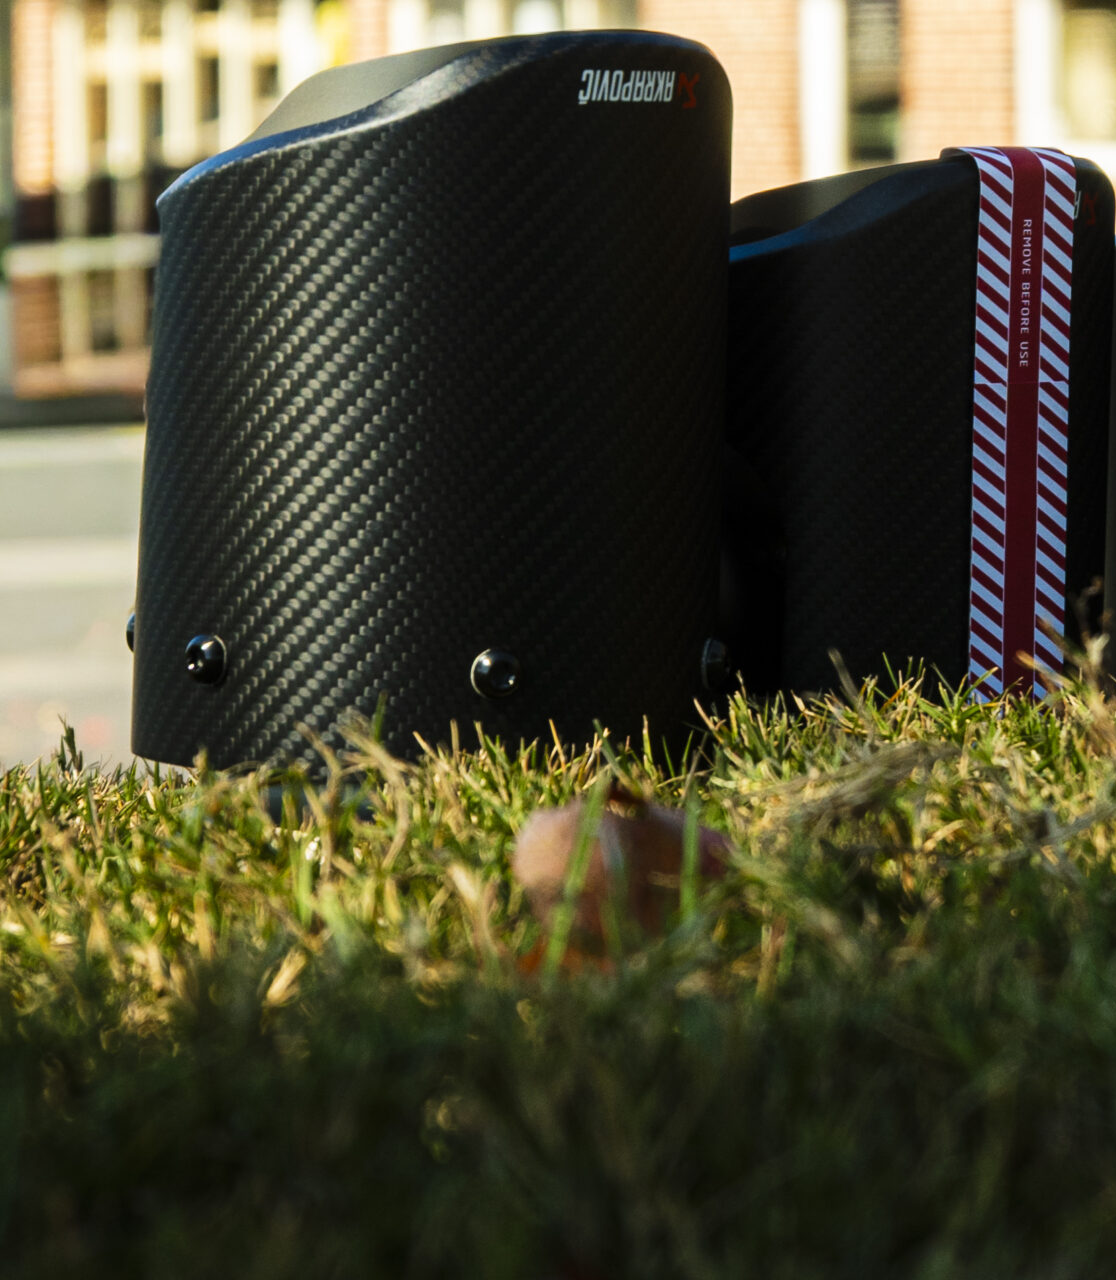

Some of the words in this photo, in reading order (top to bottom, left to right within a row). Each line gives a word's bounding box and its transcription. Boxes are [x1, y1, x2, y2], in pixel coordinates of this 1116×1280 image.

[1021, 218, 1033, 276] REMOVE
[1020, 282, 1032, 334] BEFORE
[1019, 341, 1031, 368] USE
